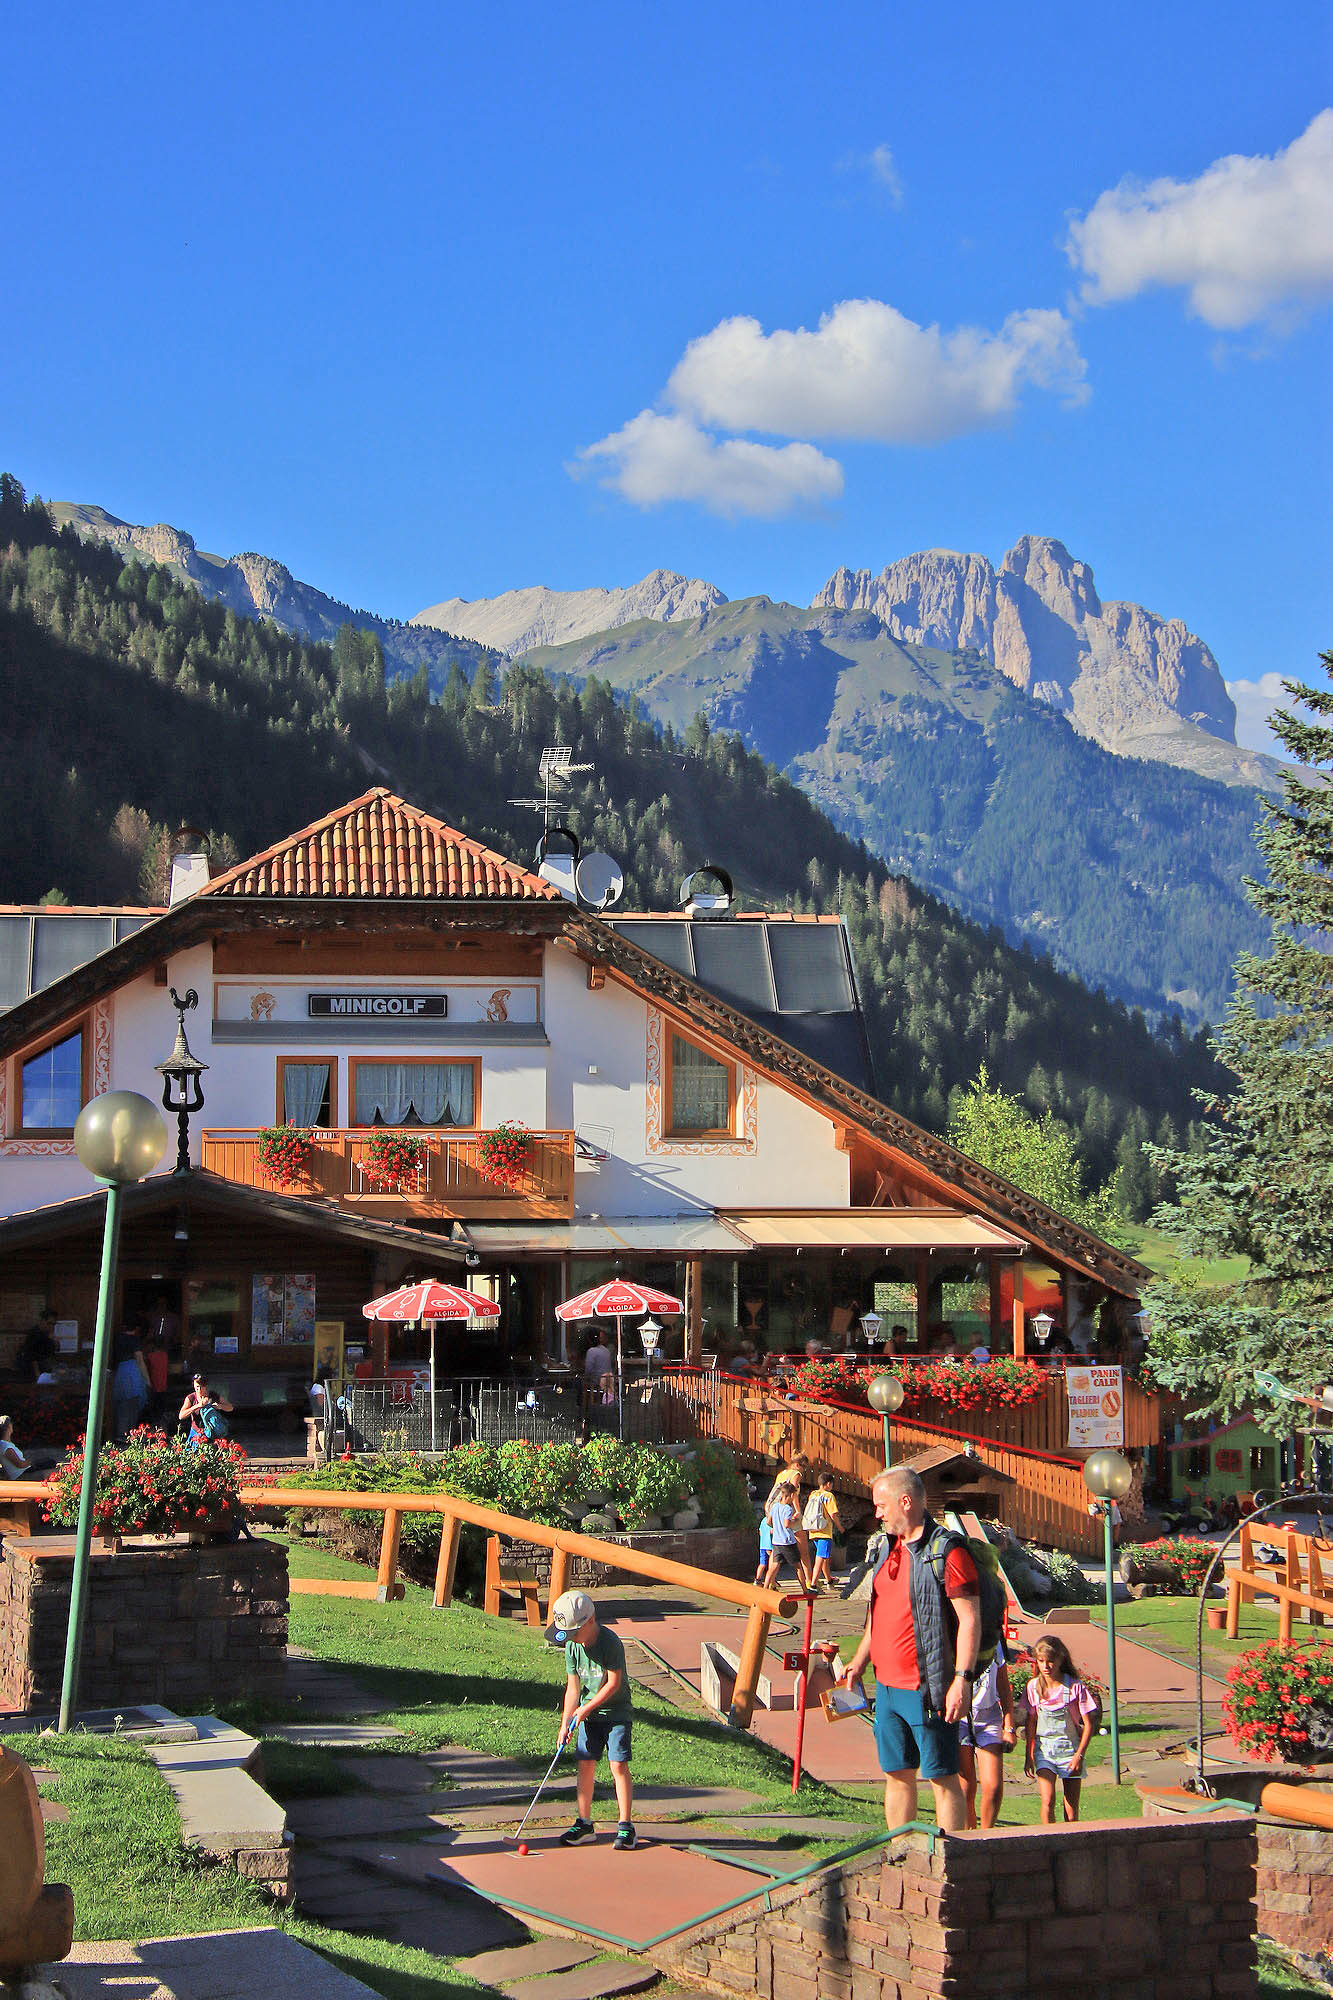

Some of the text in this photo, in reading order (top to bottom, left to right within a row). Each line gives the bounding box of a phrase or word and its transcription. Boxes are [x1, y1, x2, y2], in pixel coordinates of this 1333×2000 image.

[330, 998, 426, 1014] MINIGOLF
[1093, 1378, 1118, 1387] CALDI
[791, 1655, 799, 1668] 5
